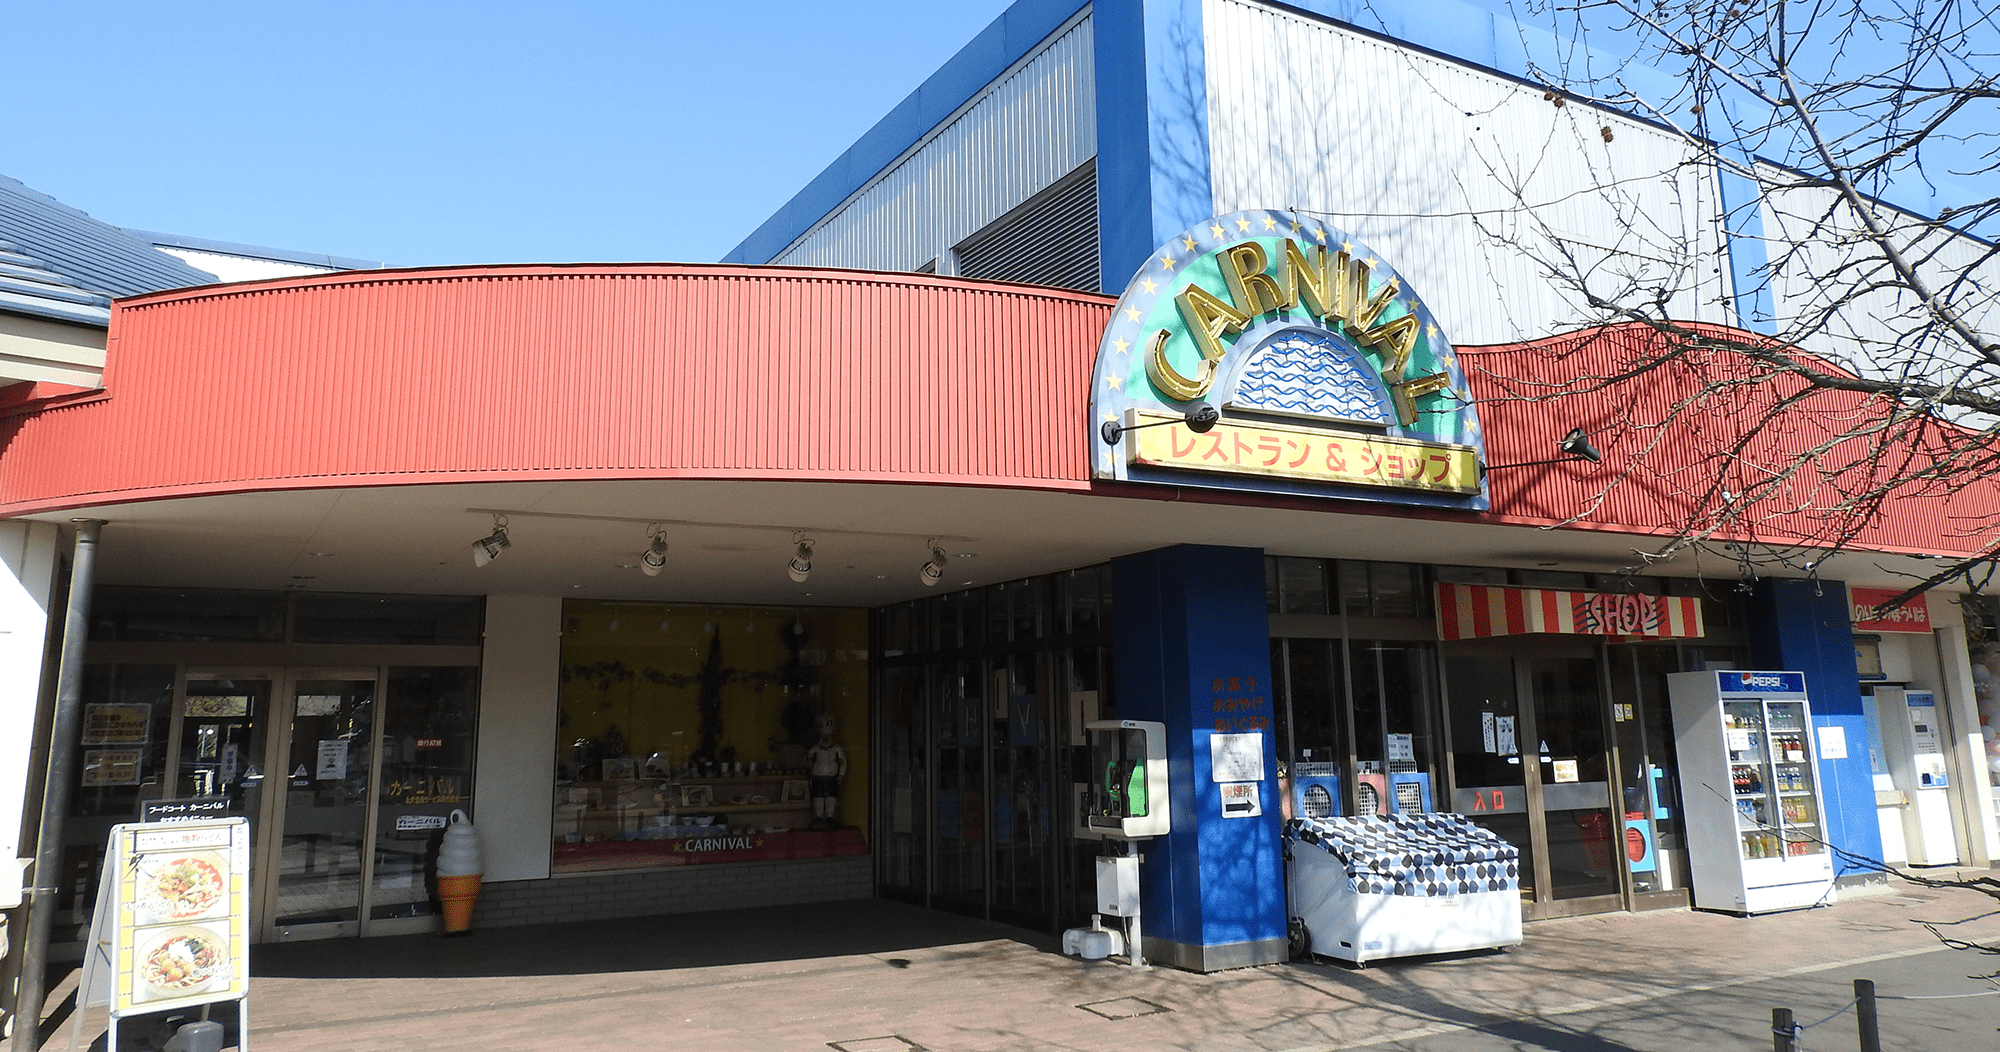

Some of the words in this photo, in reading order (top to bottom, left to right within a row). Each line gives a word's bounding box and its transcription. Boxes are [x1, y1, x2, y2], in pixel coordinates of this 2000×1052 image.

[1145, 238, 1452, 426] CARNIVAL
[1169, 424, 1312, 469] レストラン
[1325, 443, 1348, 473] &
[1362, 451, 1453, 483] ショップ
[1590, 592, 1654, 636] SHOP
[1212, 676, 1258, 693] お菓子
[1752, 676, 1781, 687] PEPSI
[1213, 696, 1264, 713] おみやげ
[390, 779, 455, 796] カーニバル
[1223, 785, 1253, 798] 喫煙所
[148, 804, 186, 815] フードコート
[189, 801, 224, 811] カーニバル
[1473, 790, 1505, 811] 入口
[685, 836, 753, 853] CARNIVAL
